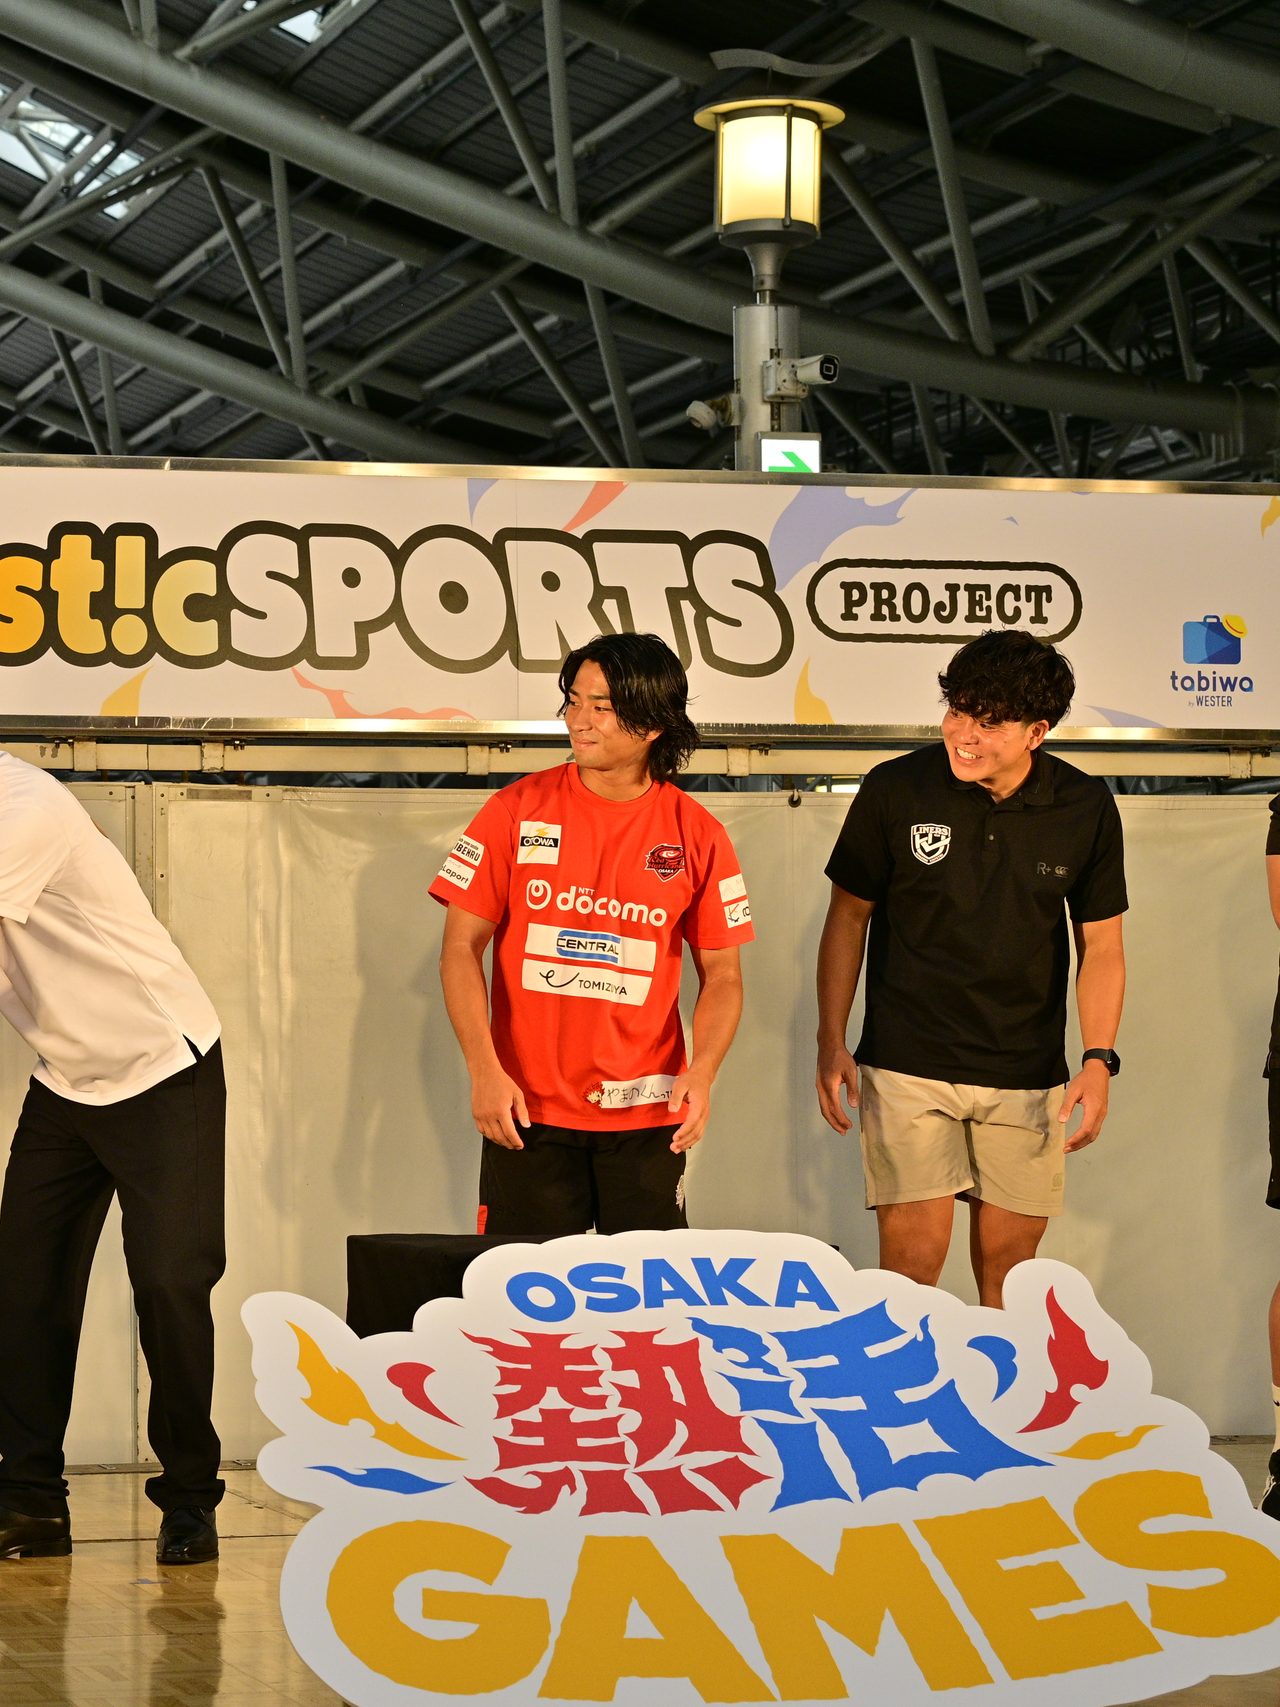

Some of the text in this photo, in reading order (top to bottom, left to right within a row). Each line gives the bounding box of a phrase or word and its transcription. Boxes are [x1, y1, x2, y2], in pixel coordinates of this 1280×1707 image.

[839, 581, 1053, 625] PROJECT
[1170, 670, 1254, 693] tabiwa
[1196, 695, 1233, 707] WESTER
[556, 885, 667, 927] docomo
[578, 886, 595, 896] NTT
[556, 937, 619, 955] CENTRAL
[505, 1257, 839, 1323] OSAKA
[327, 1469, 1280, 1704] GAMES
